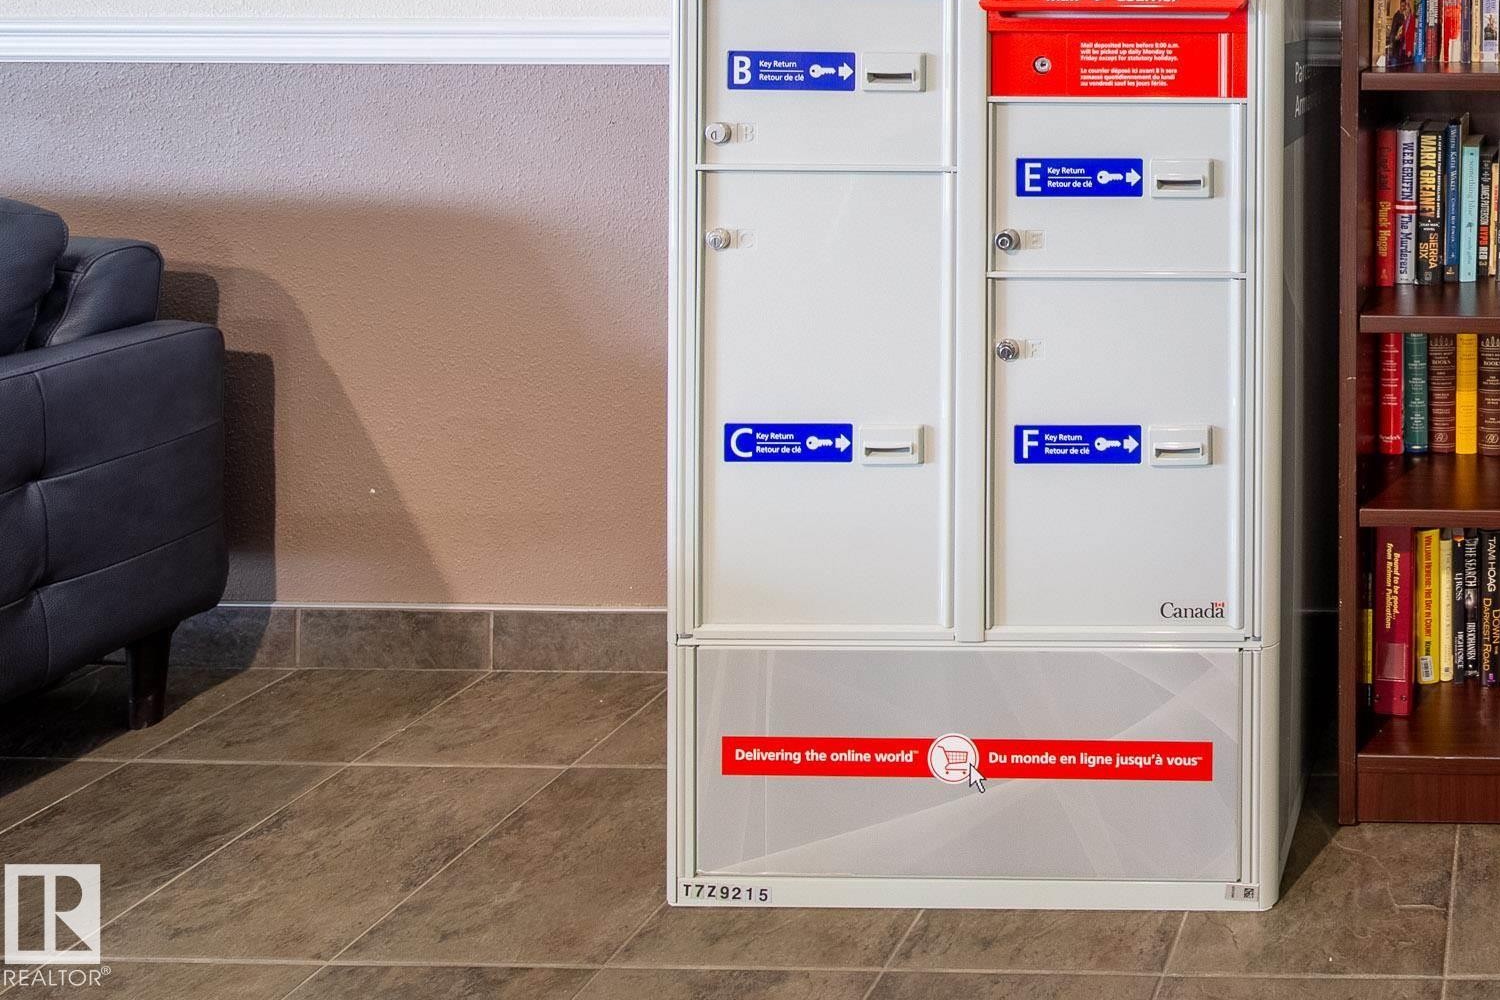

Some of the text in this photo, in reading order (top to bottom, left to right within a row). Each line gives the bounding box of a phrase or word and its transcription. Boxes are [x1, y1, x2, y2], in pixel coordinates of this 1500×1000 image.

[733, 56, 752, 84] B
[759, 60, 772, 68] Key
[1024, 163, 1042, 192] E
[1047, 166, 1085, 175] Key Return
[1420, 135, 1436, 218] MARK GREANEY
[1047, 180, 1093, 188] Retour de clé
[1401, 166, 1414, 201] GRIFFIN
[1480, 183, 1488, 200] JAMES
[1378, 201, 1391, 227] Chuck
[1480, 200, 1488, 225] PATTERSON
[1377, 230, 1390, 257] Hogan
[1400, 215, 1412, 275] The Murderers
[1480, 226, 1488, 246] NYPD
[1419, 242, 1428, 259] SIX
[1428, 232, 1438, 269] SIERRA
[1480, 246, 1488, 260] RED
[730, 427, 753, 458] C
[756, 432, 794, 441] Key Return
[1023, 429, 1039, 459] F
[1044, 434, 1057, 442] Key
[1465, 543, 1477, 587] THE SEARCH
[1487, 536, 1496, 592] TAMI HOAG
[1393, 585, 1399, 594] be
[1394, 576, 1400, 584] to
[1160, 601, 1224, 619] Canada
[1482, 597, 1491, 671] DARKEST ROAD
[1492, 608, 1500, 644] DOWN
[735, 749, 801, 764] Delivering
[805, 749, 827, 762] the
[830, 749, 871, 762] online
[988, 751, 1007, 763] Du
[1010, 752, 1056, 764] monde
[1060, 755, 1076, 764] en
[1080, 752, 1112, 768] ligne
[1115, 754, 1163, 768] jusqu'à
[683, 884, 769, 902] T7Z9215
